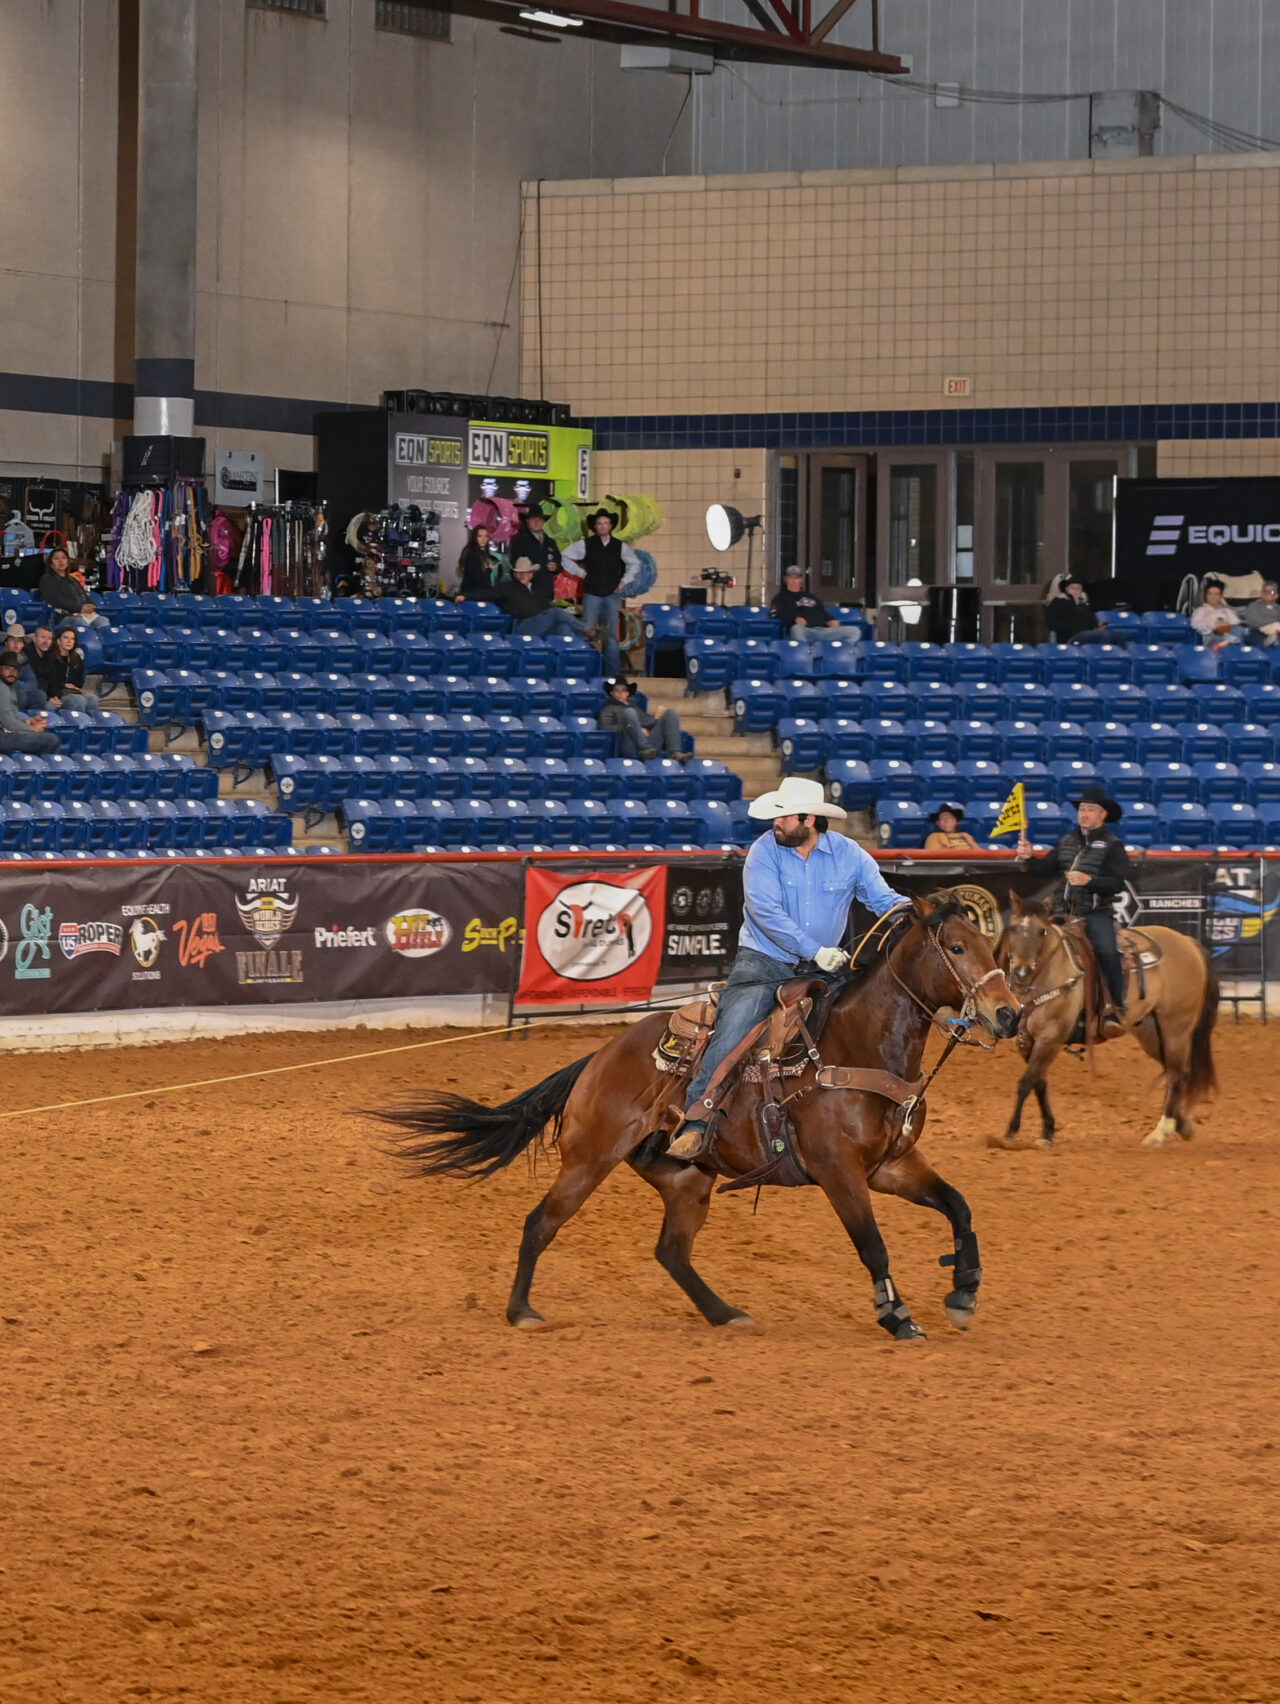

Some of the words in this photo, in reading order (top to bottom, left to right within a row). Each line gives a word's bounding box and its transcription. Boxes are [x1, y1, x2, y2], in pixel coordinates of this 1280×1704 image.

[948, 378, 967, 394] EXIT
[398, 437, 426, 465] EQN
[428, 439, 462, 466] SPORTS
[472, 428, 504, 467] EQN
[508, 434, 548, 468] SPORTS
[248, 878, 288, 892] ARIAT
[1149, 899, 1202, 908] RANCHES
[79, 922, 123, 945] ROPER
[314, 924, 377, 948] Priefert
[667, 934, 727, 955] SIMPLE.
[235, 950, 303, 985] FINALE
